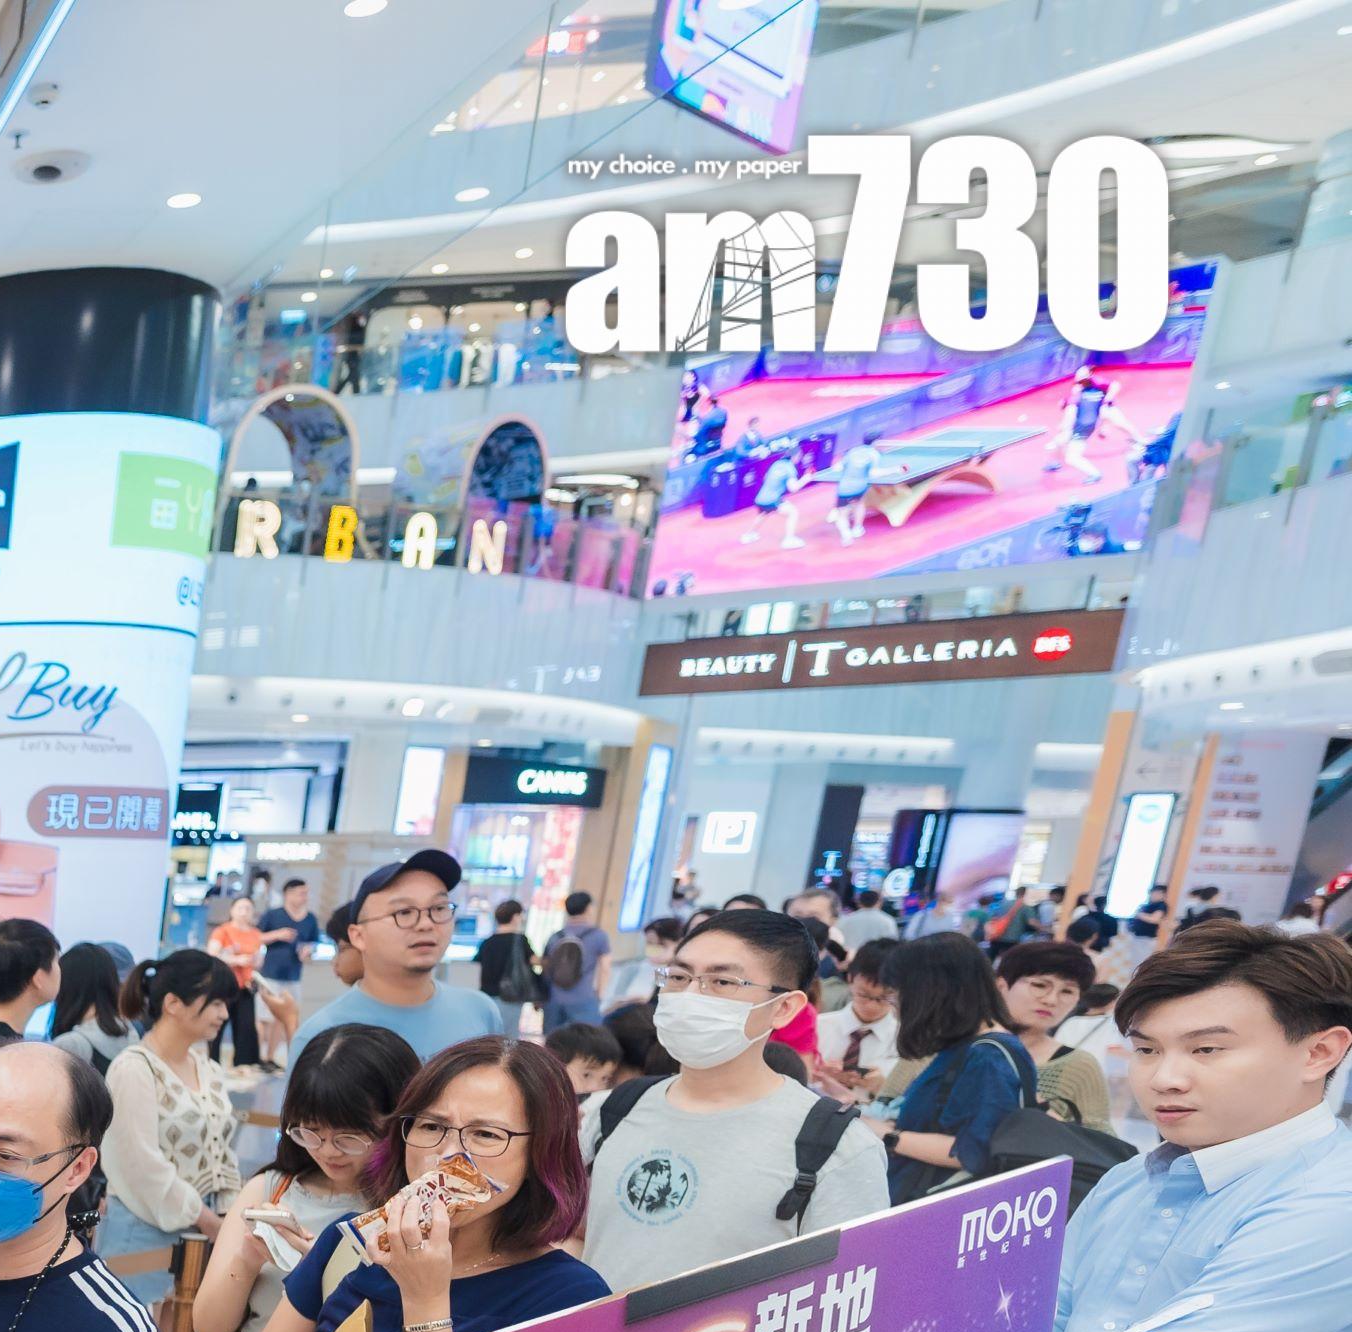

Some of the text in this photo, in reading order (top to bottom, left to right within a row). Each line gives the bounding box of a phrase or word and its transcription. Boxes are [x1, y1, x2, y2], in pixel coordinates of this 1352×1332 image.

[679, 653, 777, 678] BEAUTY
[845, 637, 1018, 669] GALLERIA
[45, 793, 164, 831] 現已開幕
[958, 1186, 1058, 1255] MOKO
